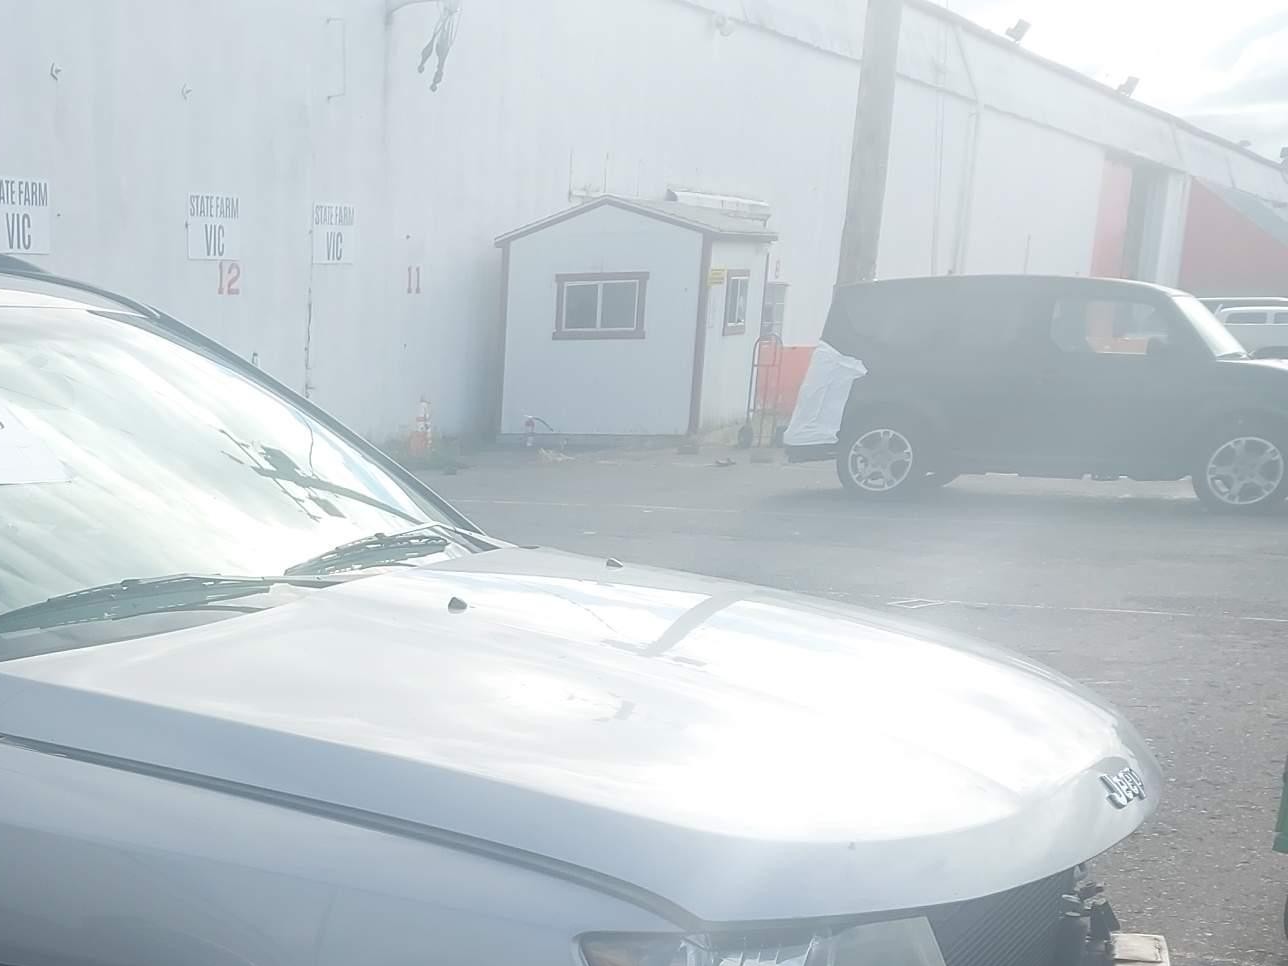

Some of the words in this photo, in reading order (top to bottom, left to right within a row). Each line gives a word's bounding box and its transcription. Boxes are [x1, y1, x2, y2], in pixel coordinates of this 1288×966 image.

[18, 180, 48, 207] FARM
[189, 194, 214, 218] STATE
[215, 196, 239, 219] FARM
[314, 204, 334, 225] STATE
[6, 212, 31, 250] VIC
[205, 223, 225, 257] VIC
[326, 231, 343, 261] VIC
[217, 260, 241, 295] 12
[407, 265, 420, 294] 11
[1099, 768, 1146, 810] Jeep
